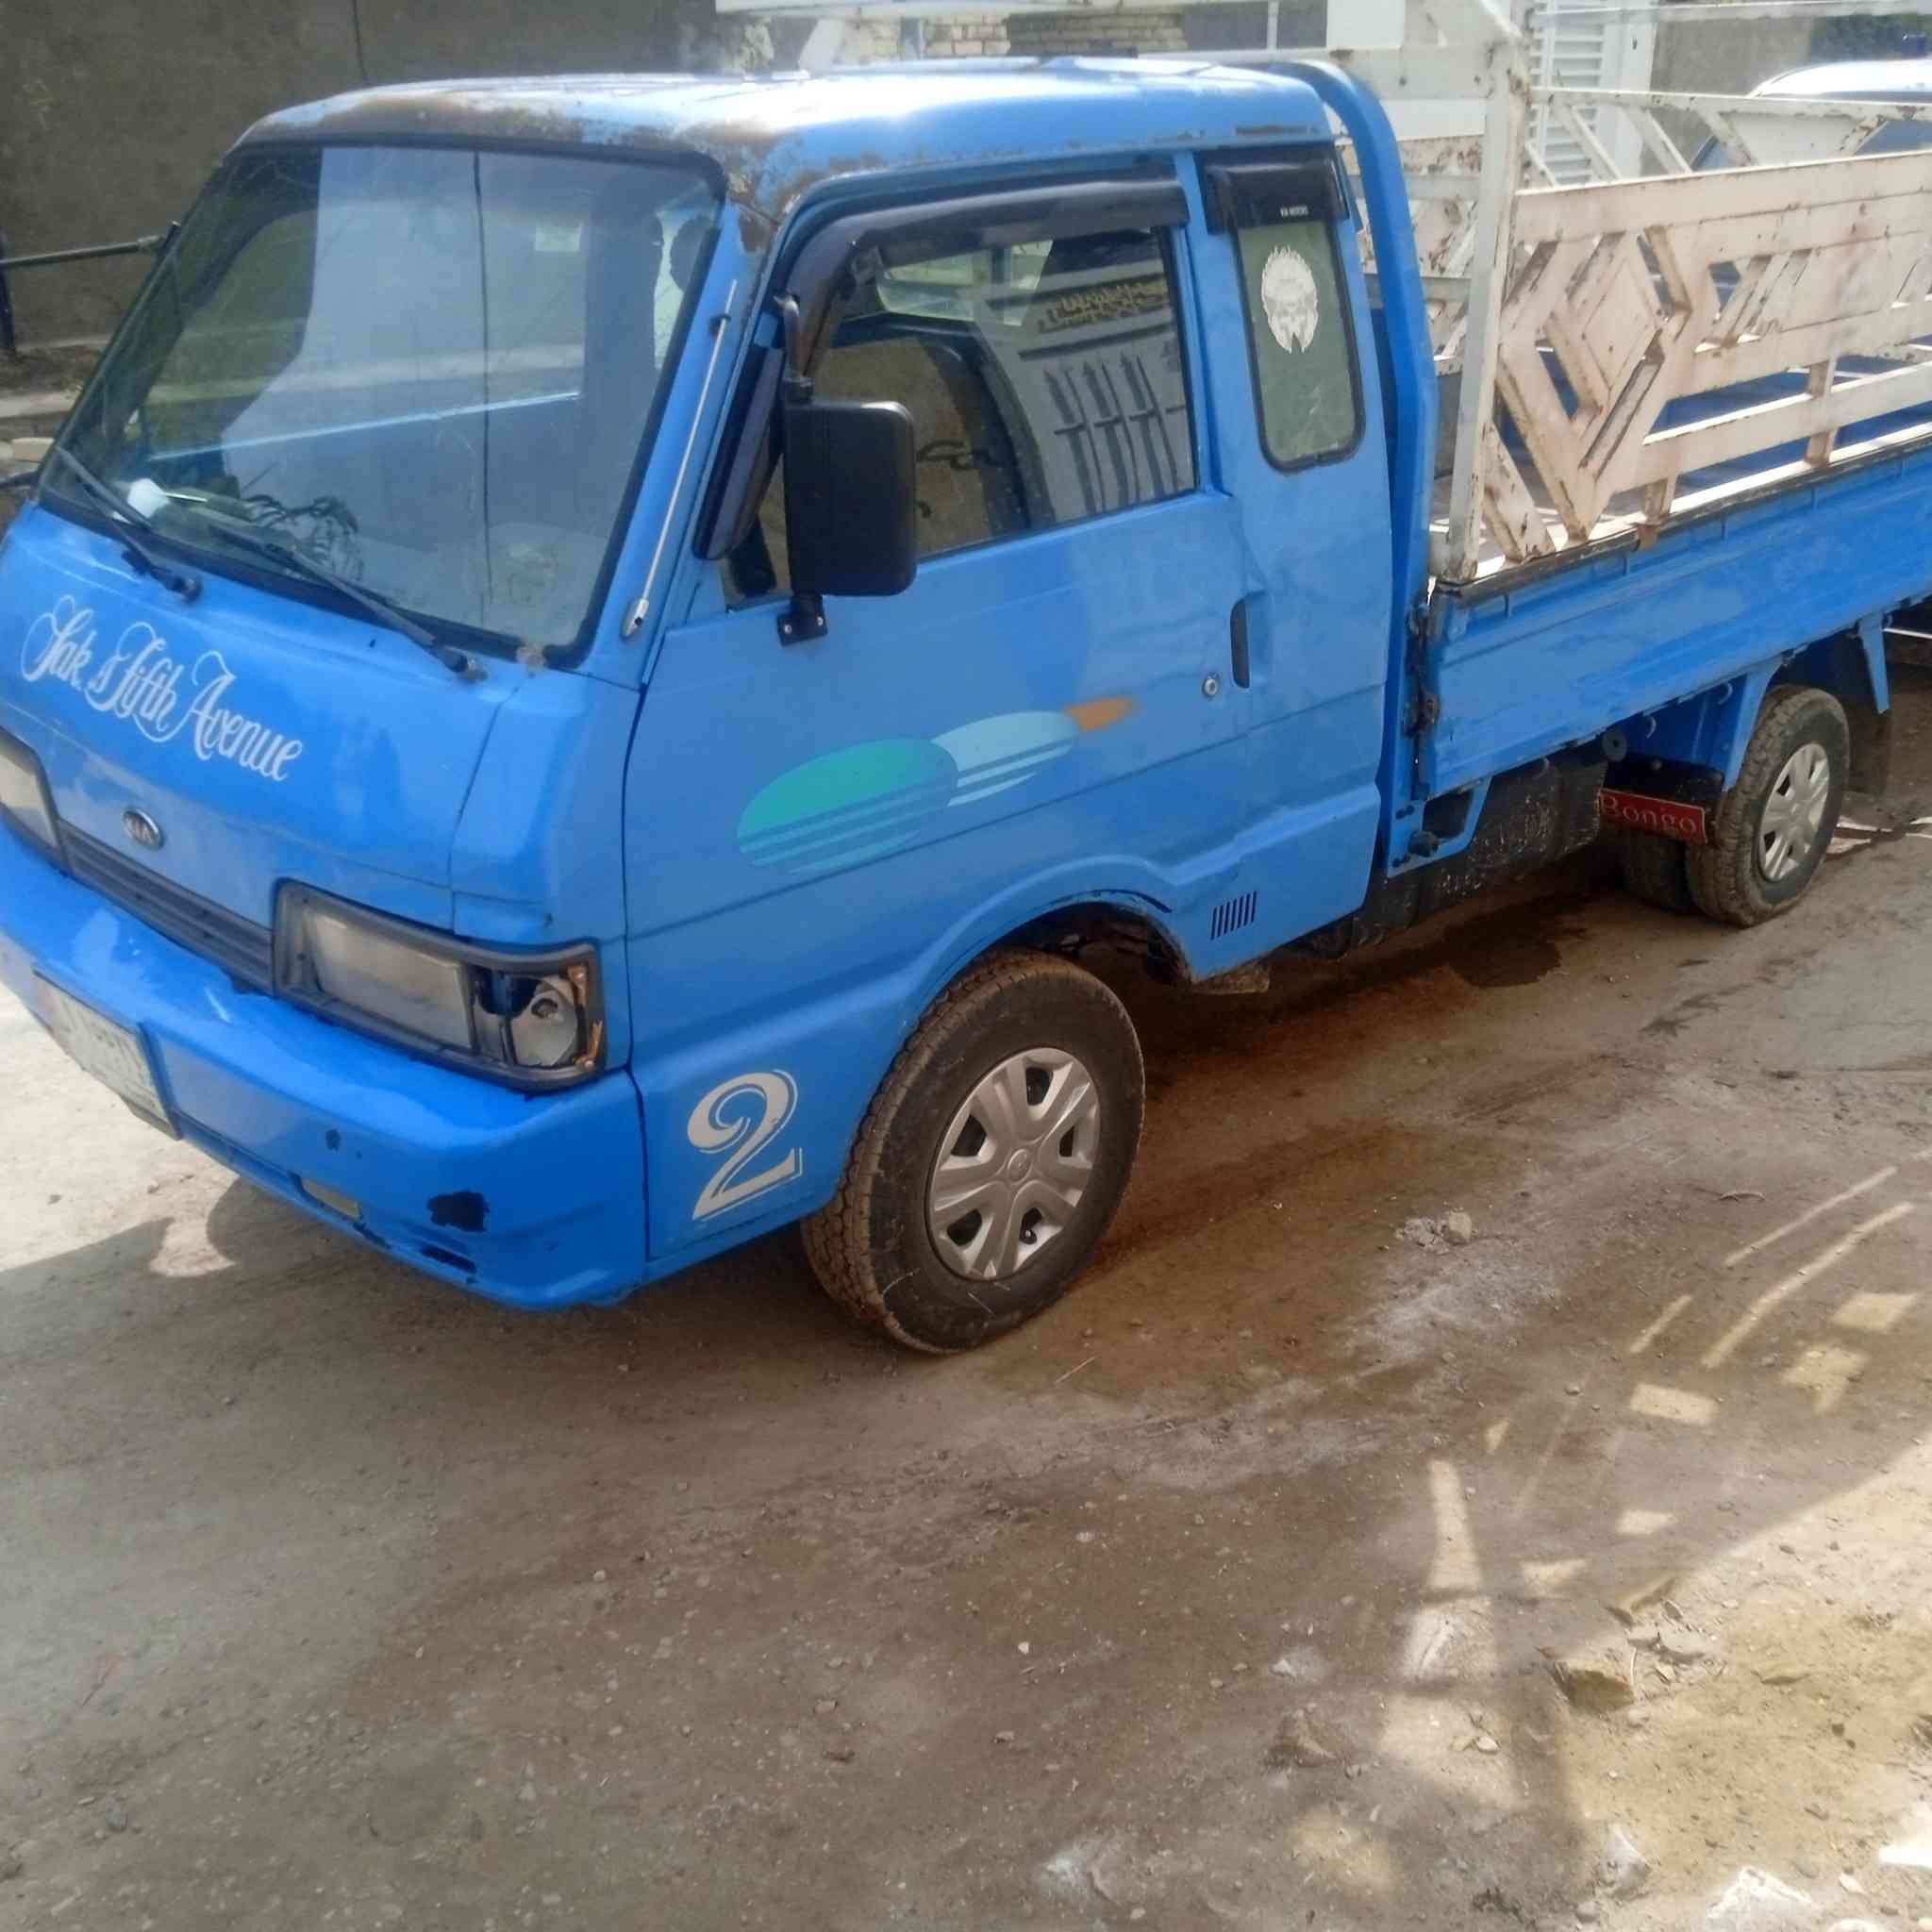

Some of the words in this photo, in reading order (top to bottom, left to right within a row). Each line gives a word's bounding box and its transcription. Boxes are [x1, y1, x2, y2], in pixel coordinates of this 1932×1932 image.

[133, 650, 303, 781] Avenue
[1601, 794, 1697, 835] Bongo
[688, 1069, 803, 1222] 2
